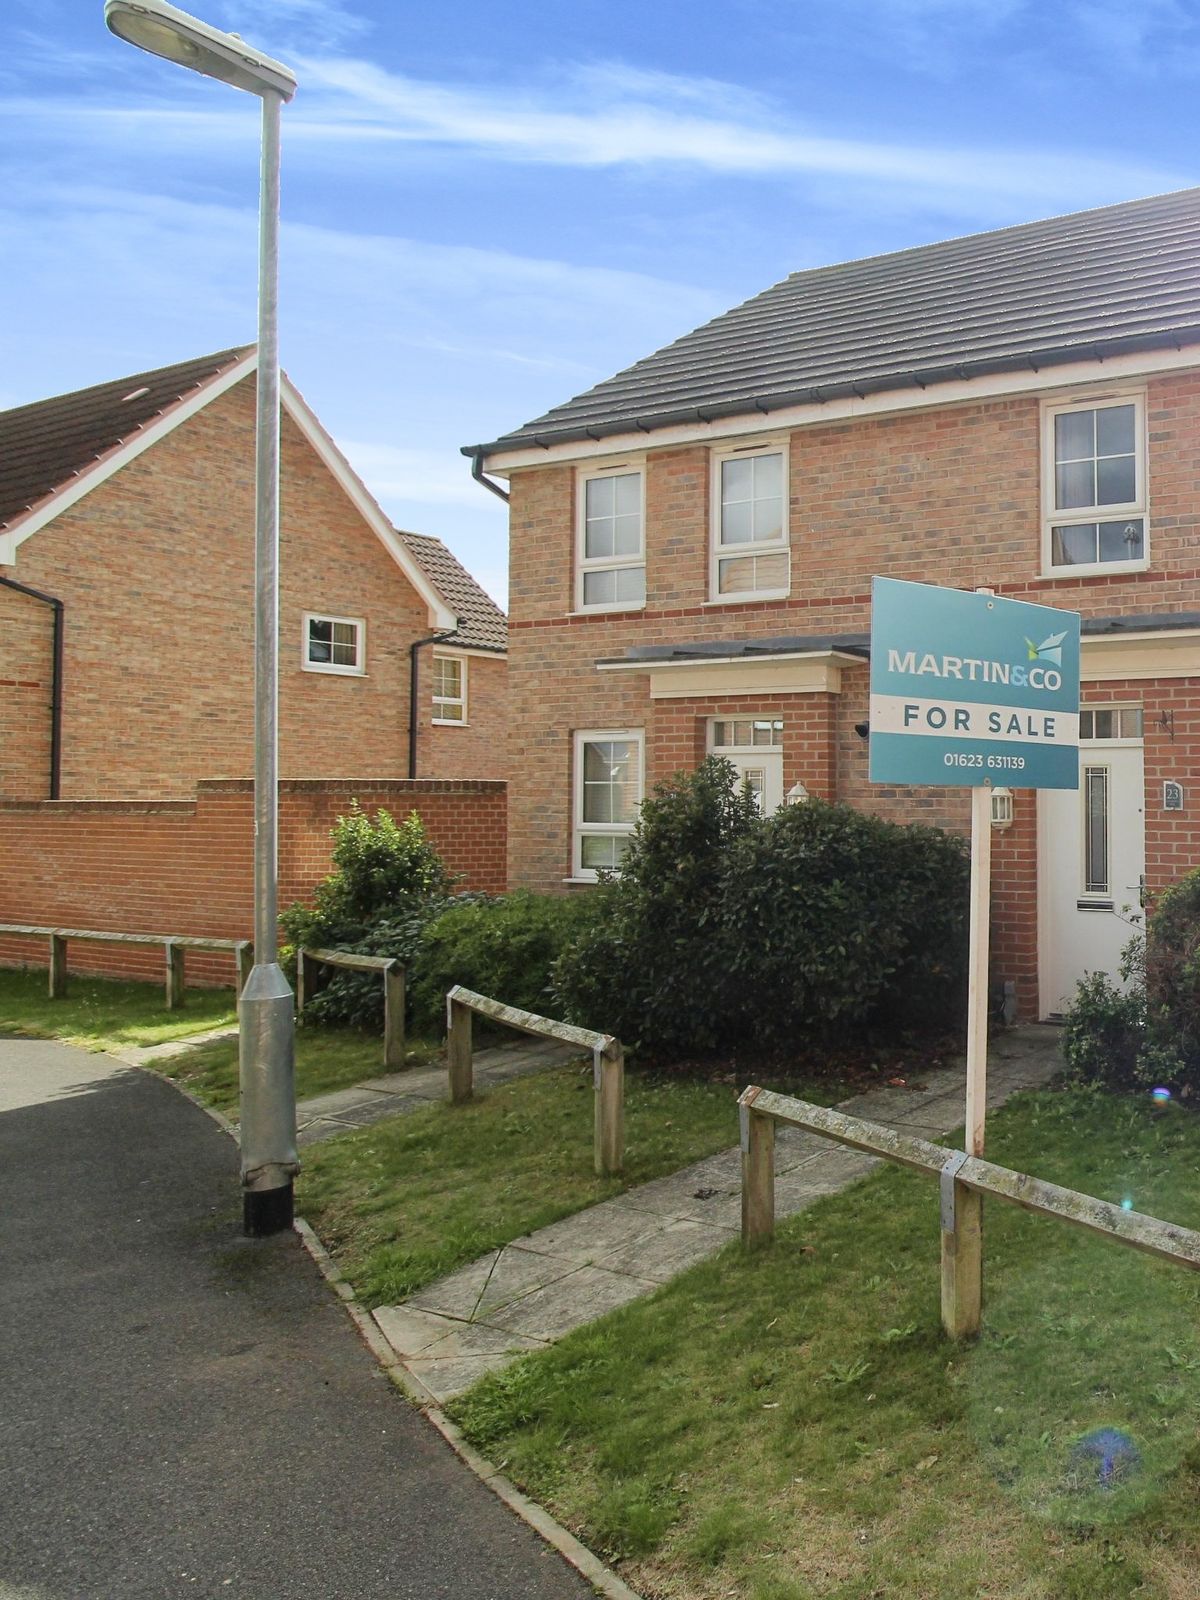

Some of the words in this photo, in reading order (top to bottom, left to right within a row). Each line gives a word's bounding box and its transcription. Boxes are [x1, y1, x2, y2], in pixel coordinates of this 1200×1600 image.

[888, 649, 1062, 691] MARTIN&CO
[904, 704, 970, 731] FOR
[988, 711, 1055, 738] SALE
[944, 753, 983, 767] 01623
[987, 755, 1024, 769] 631139
[1166, 788, 1179, 800] 23
